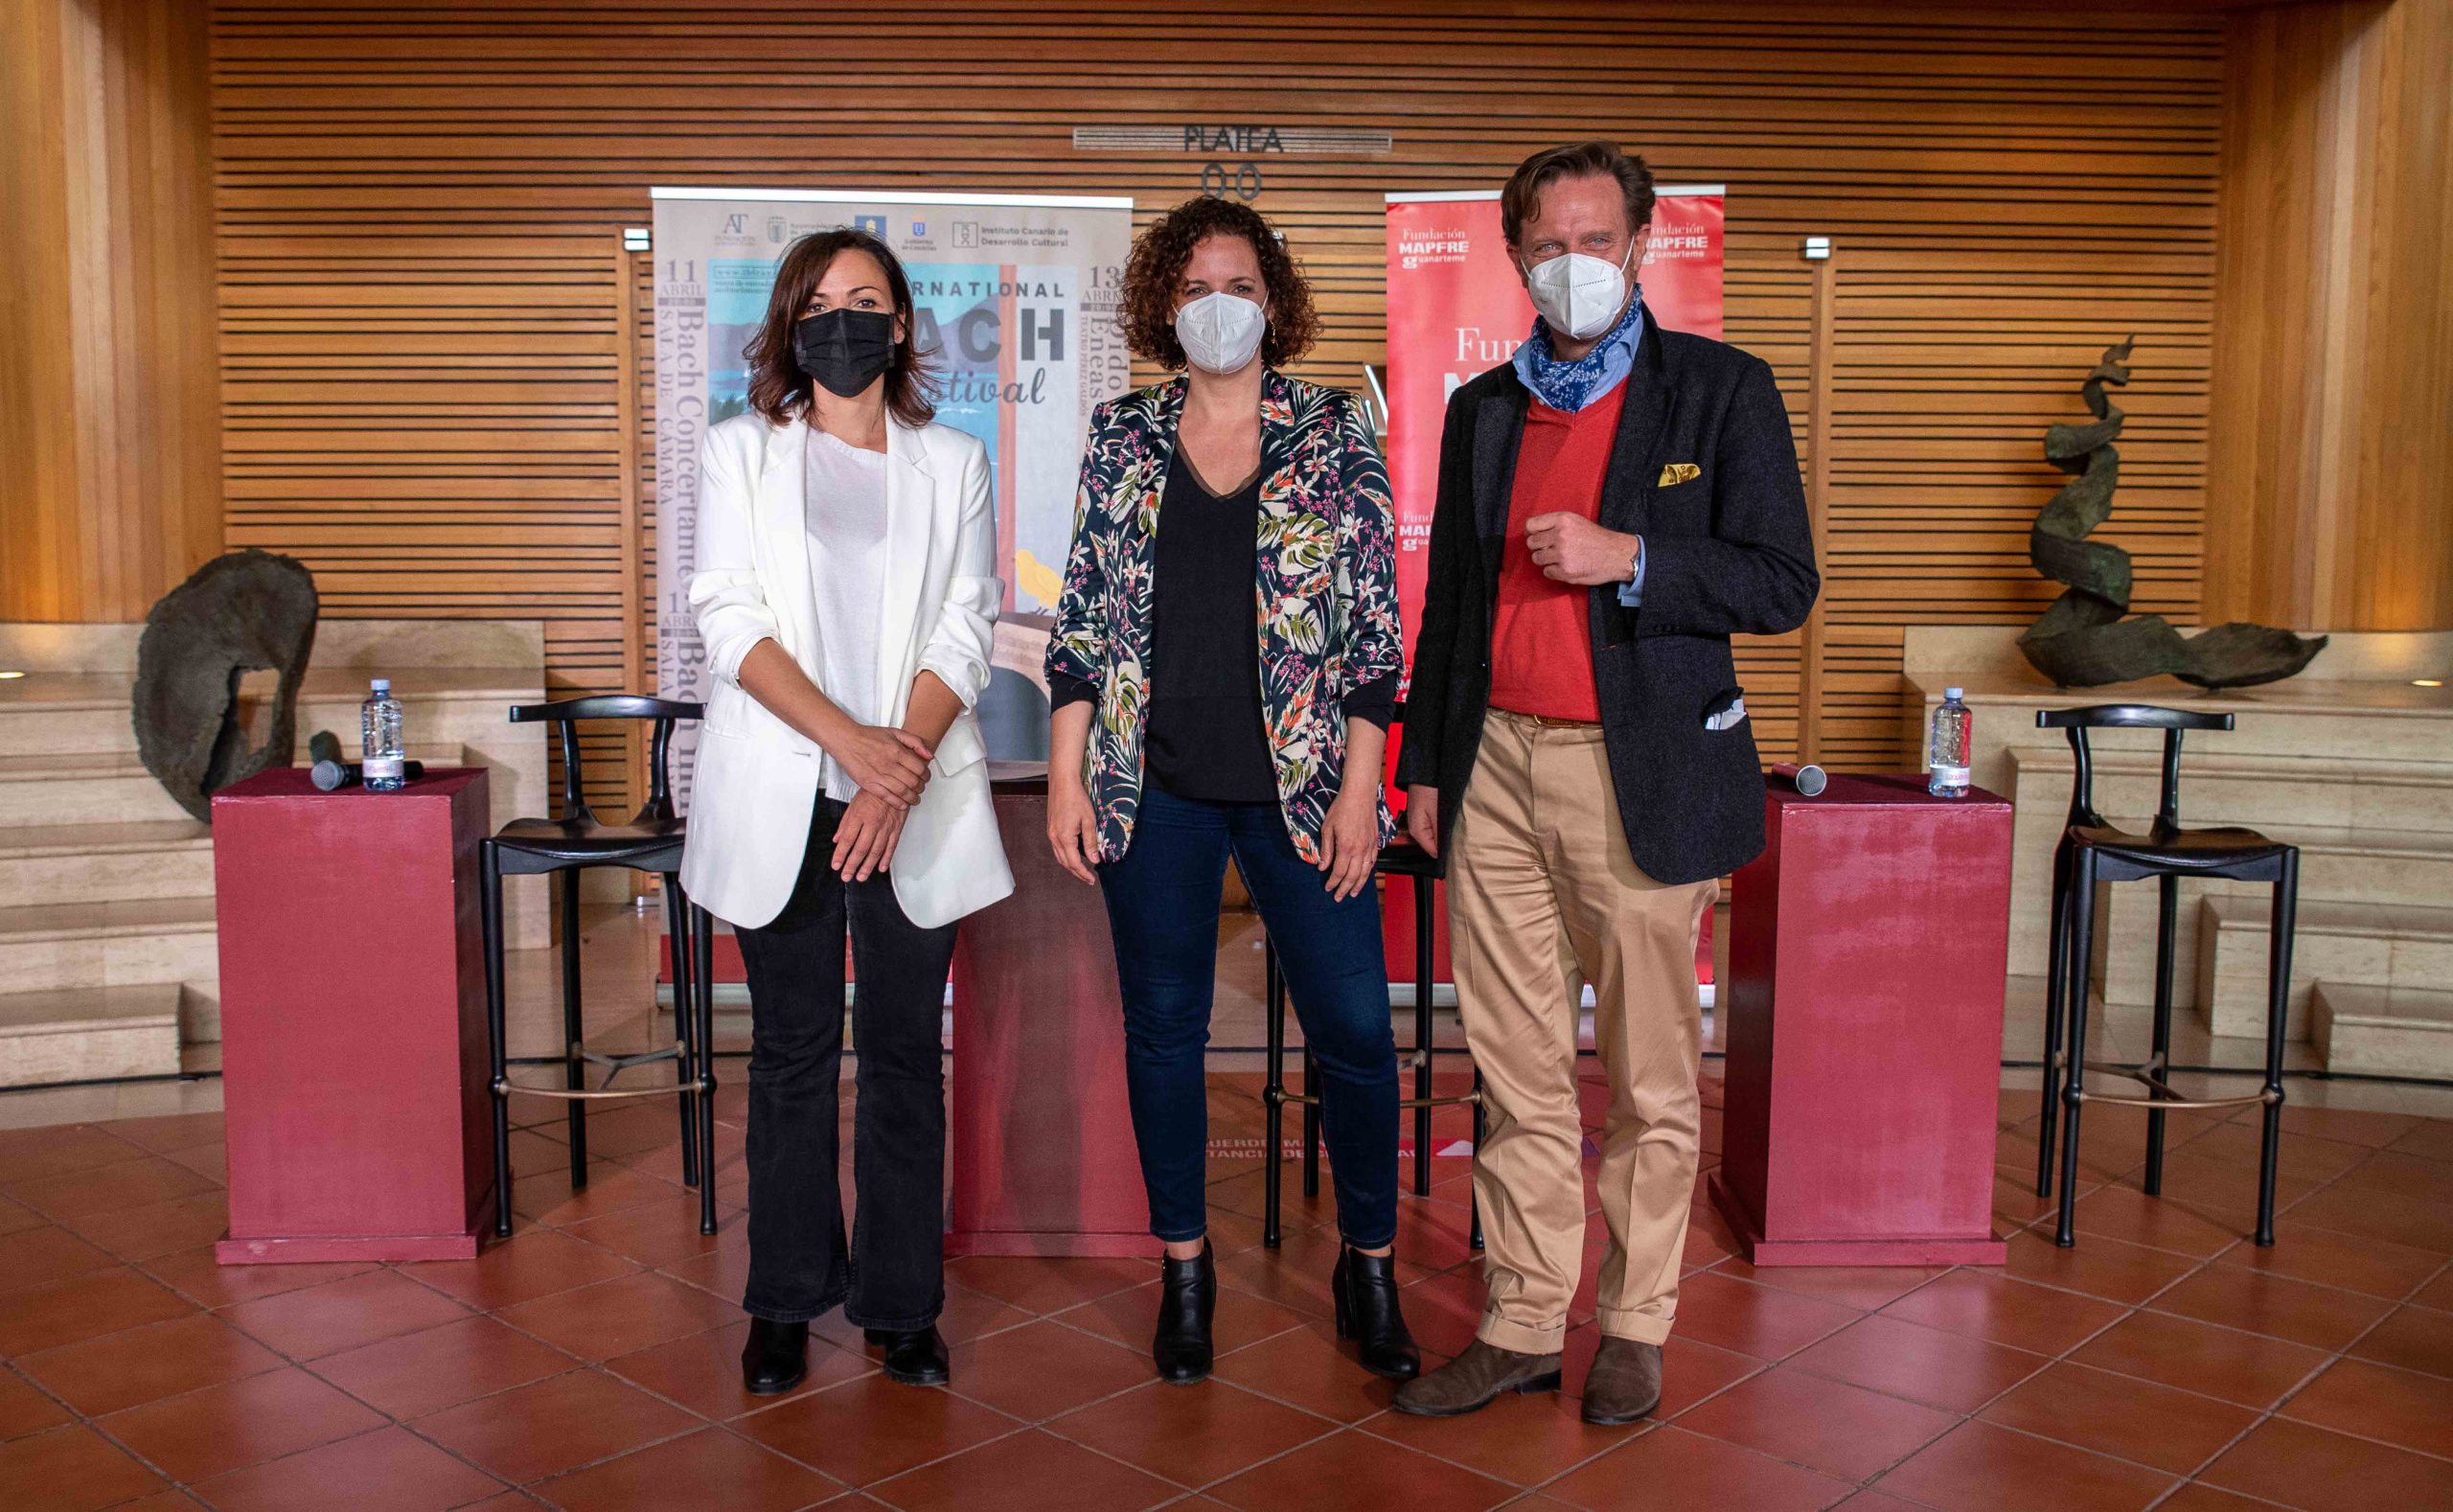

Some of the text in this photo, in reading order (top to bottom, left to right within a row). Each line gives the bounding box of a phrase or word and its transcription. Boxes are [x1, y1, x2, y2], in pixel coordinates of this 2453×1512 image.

[1184, 124, 1283, 152] PLATEA
[981, 226, 1068, 237] Instituto Canario de
[1403, 228, 1465, 241] Fundación
[1652, 222, 1705, 235] undación
[981, 237, 1068, 247] Desarrollo Cultural
[1398, 241, 1470, 254] MAPFRE
[1646, 235, 1708, 249] APFRE
[1402, 255, 1466, 268] guanarteme
[667, 260, 697, 283] 11
[660, 284, 702, 296] ABRIL
[912, 282, 1065, 298] RNATIONAL
[1082, 289, 1119, 302] ABRI
[660, 310, 674, 363] SALA
[915, 307, 1065, 363] ACH
[677, 309, 704, 388] Bach
[1089, 317, 1109, 399] Eneas
[660, 374, 674, 398] DE
[660, 640, 674, 692] SALA
[1206, 1150, 1267, 1158] TANCI
